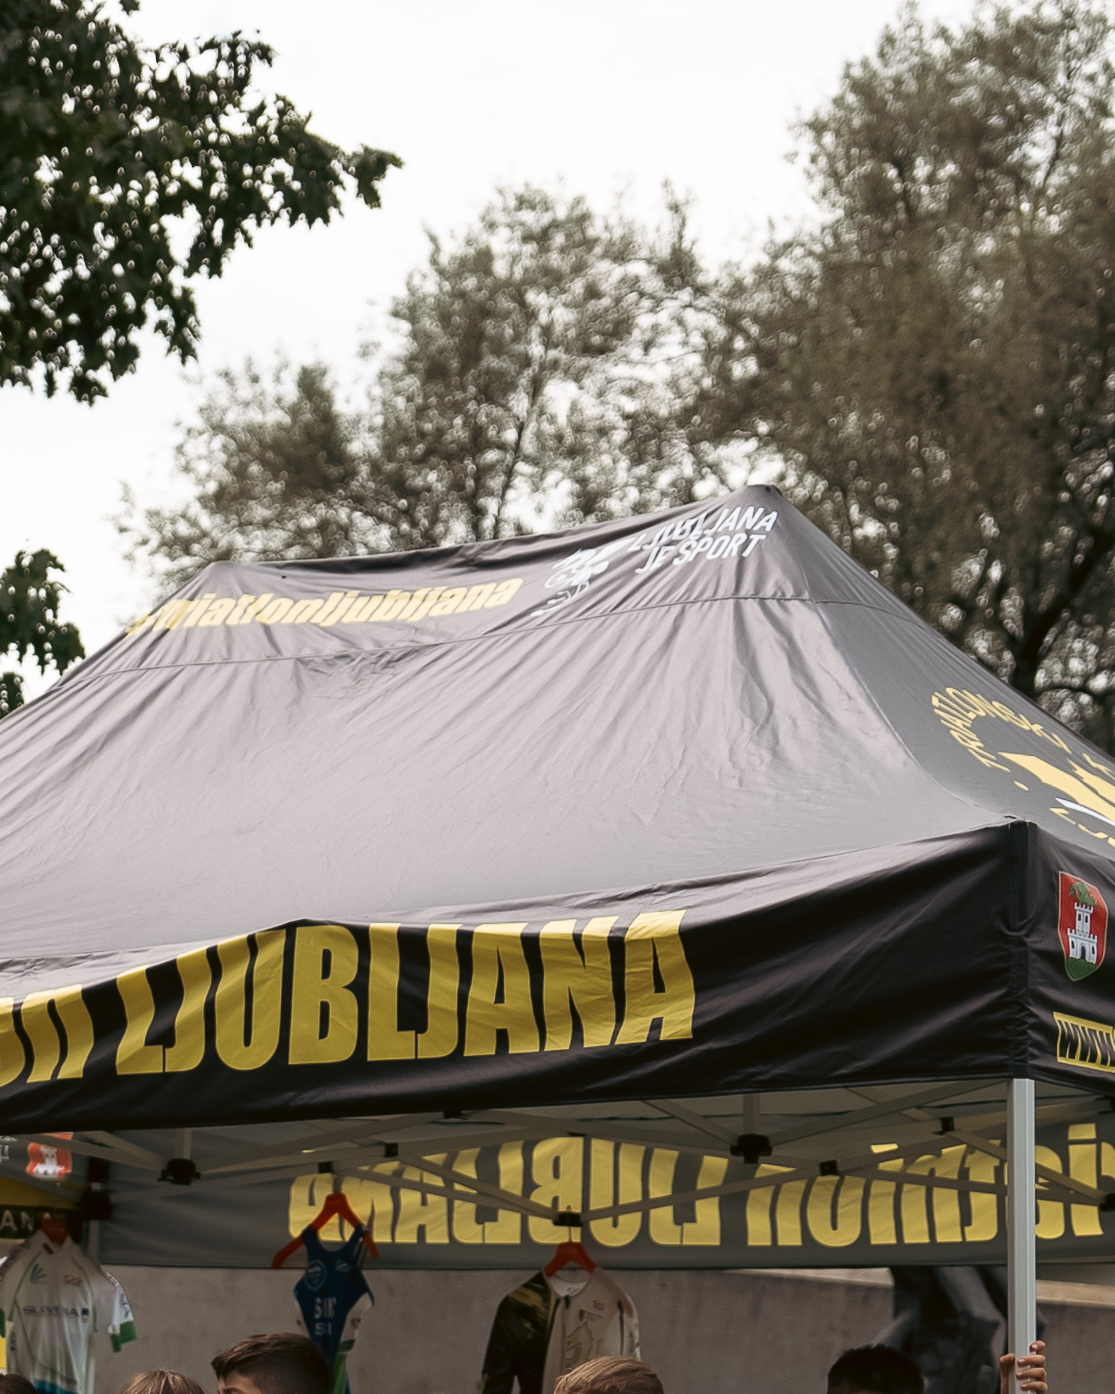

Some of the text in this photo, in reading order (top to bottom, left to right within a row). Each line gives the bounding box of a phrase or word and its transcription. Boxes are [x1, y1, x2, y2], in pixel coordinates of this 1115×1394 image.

[627, 505, 779, 552] LJUBLJANA
[635, 532, 767, 574] JE SPORT
[115, 910, 697, 1076] LJUBLJANA
